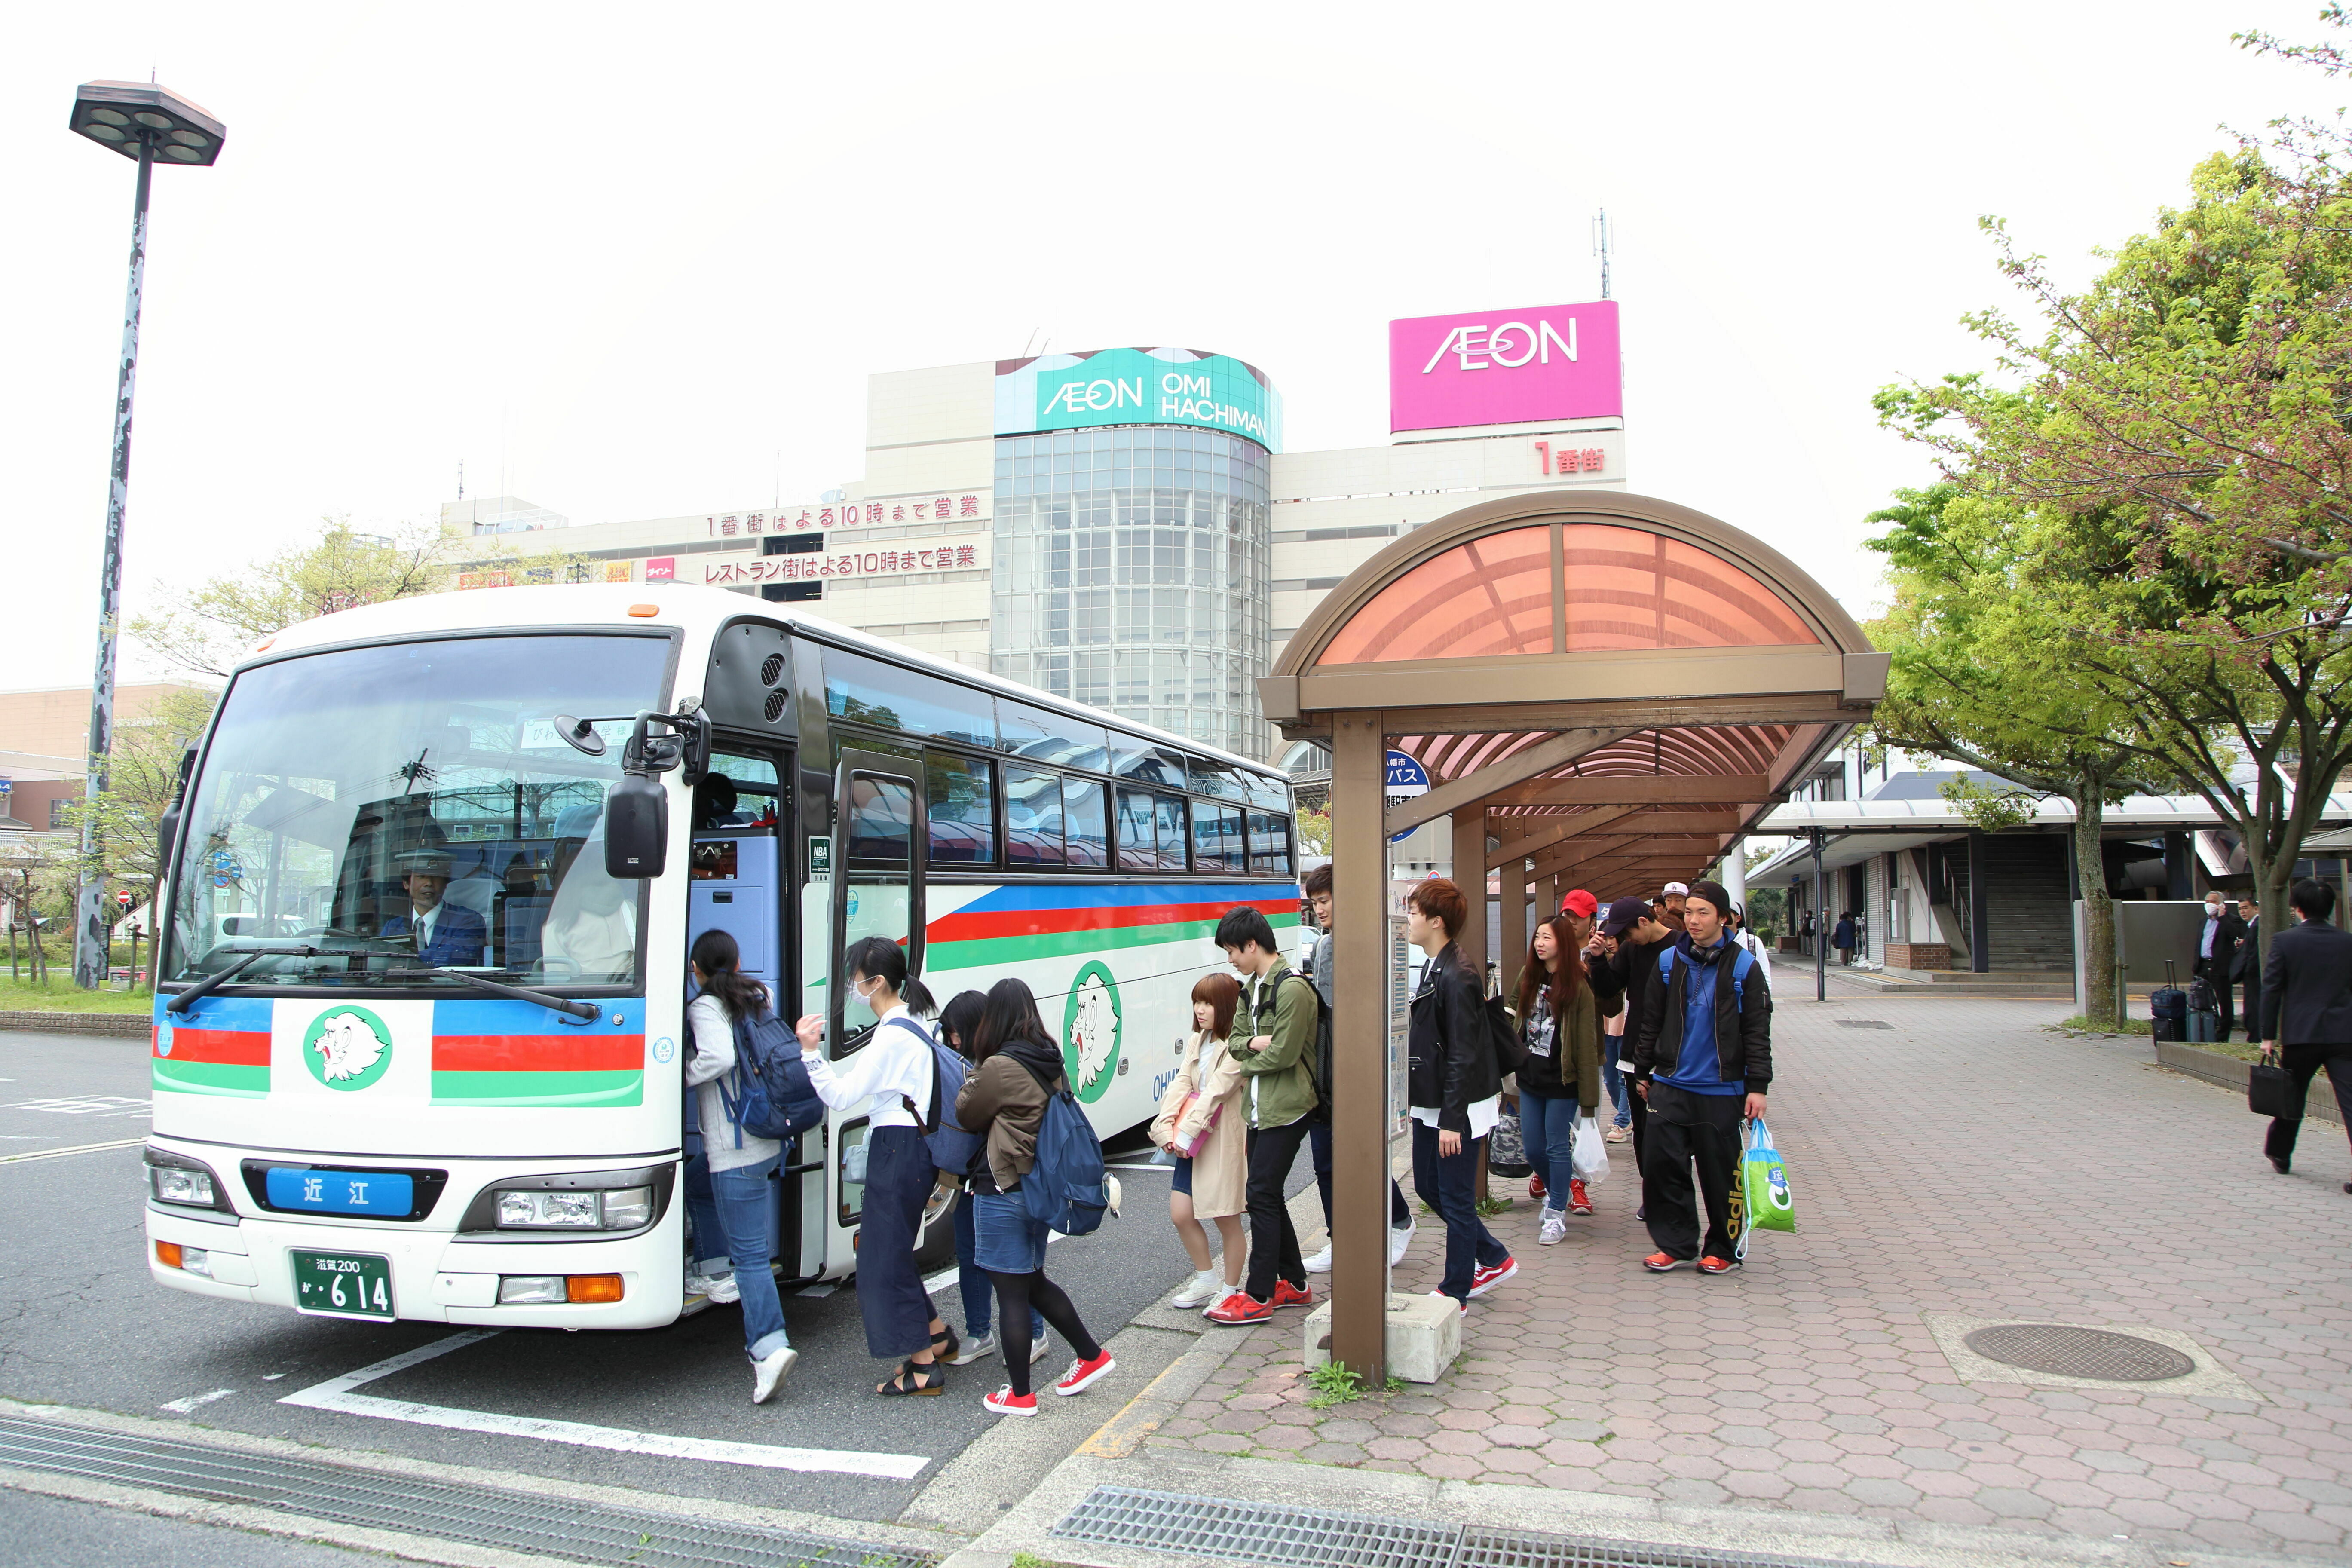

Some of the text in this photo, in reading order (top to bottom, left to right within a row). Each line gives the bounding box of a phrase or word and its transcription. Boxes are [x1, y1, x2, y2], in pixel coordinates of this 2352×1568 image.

[1162, 373, 1210, 398] OMI
[1162, 396, 1266, 439] HACHIMAN
[1535, 441, 1605, 474] 1番街
[647, 567, 671, 576] ダイソー
[705, 544, 976, 584] レストラン街はよる10時まで営業
[1387, 769, 1418, 783] バス
[814, 846, 827, 857] NBA
[1153, 1068, 1180, 1102] OHM
[304, 1178, 369, 1204] 近江
